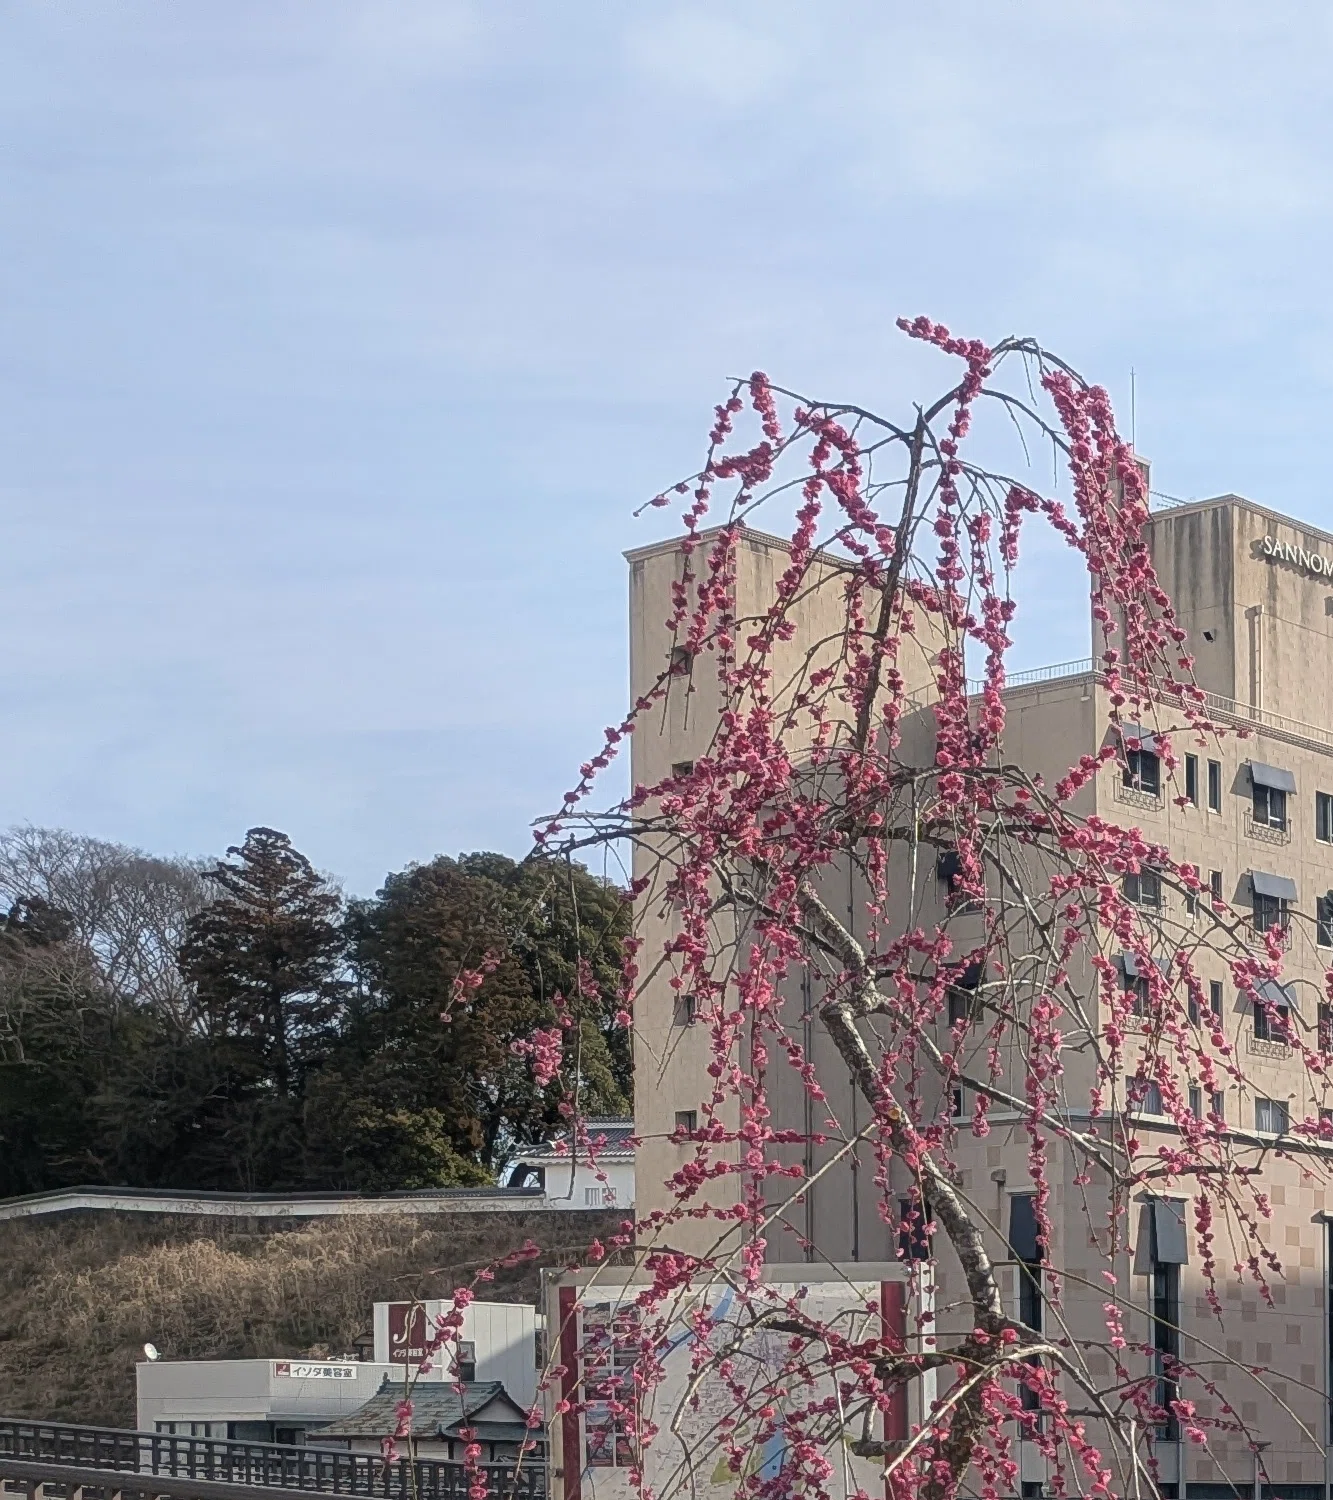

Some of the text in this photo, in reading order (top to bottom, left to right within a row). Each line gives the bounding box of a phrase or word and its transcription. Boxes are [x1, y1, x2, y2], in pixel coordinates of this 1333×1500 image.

[292, 1366, 353, 1378] イソダ美容室
